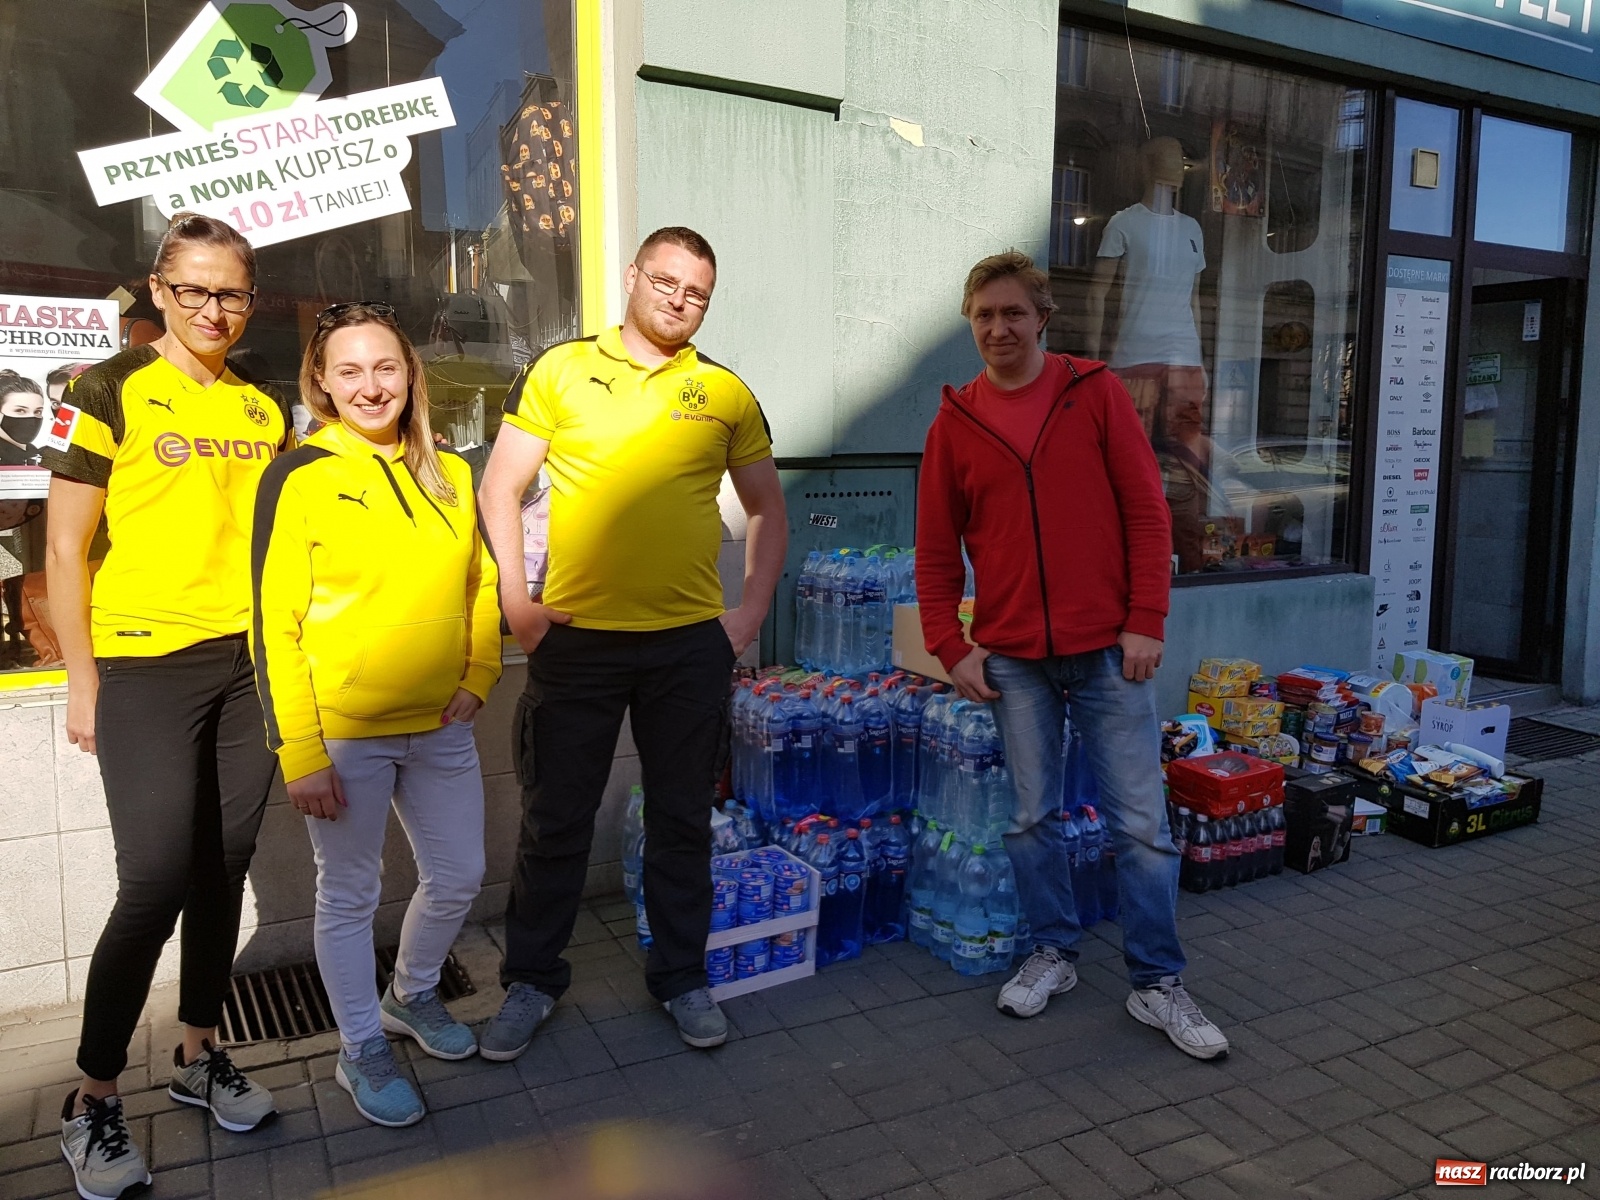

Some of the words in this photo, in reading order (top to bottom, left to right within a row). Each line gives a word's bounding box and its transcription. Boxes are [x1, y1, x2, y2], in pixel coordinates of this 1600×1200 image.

[103, 133, 239, 186] PRZYNIEŚ
[237, 113, 339, 155] STARĄ
[328, 95, 439, 134] TOREBKĘ
[169, 192, 186, 209] a
[190, 170, 277, 203] NOWĄ
[274, 138, 381, 183] KUPISZ
[383, 143, 398, 159] o
[229, 201, 274, 234] 10
[279, 190, 310, 222] zł
[310, 179, 392, 214] TANIEJ!
[1388, 267, 1425, 282] DOSTĘPNE
[15, 347, 56, 356] wymiennym
[56, 348, 81, 356] filtrem
[1389, 377, 1405, 385] FILA
[682, 388, 706, 404] BVB
[247, 406, 267, 421] BVB
[688, 402, 698, 410] 09
[1412, 427, 1437, 436] Barbour
[811, 513, 837, 527] WEST
[1431, 719, 1454, 733] SYROP
[1466, 812, 1487, 834] 3L
